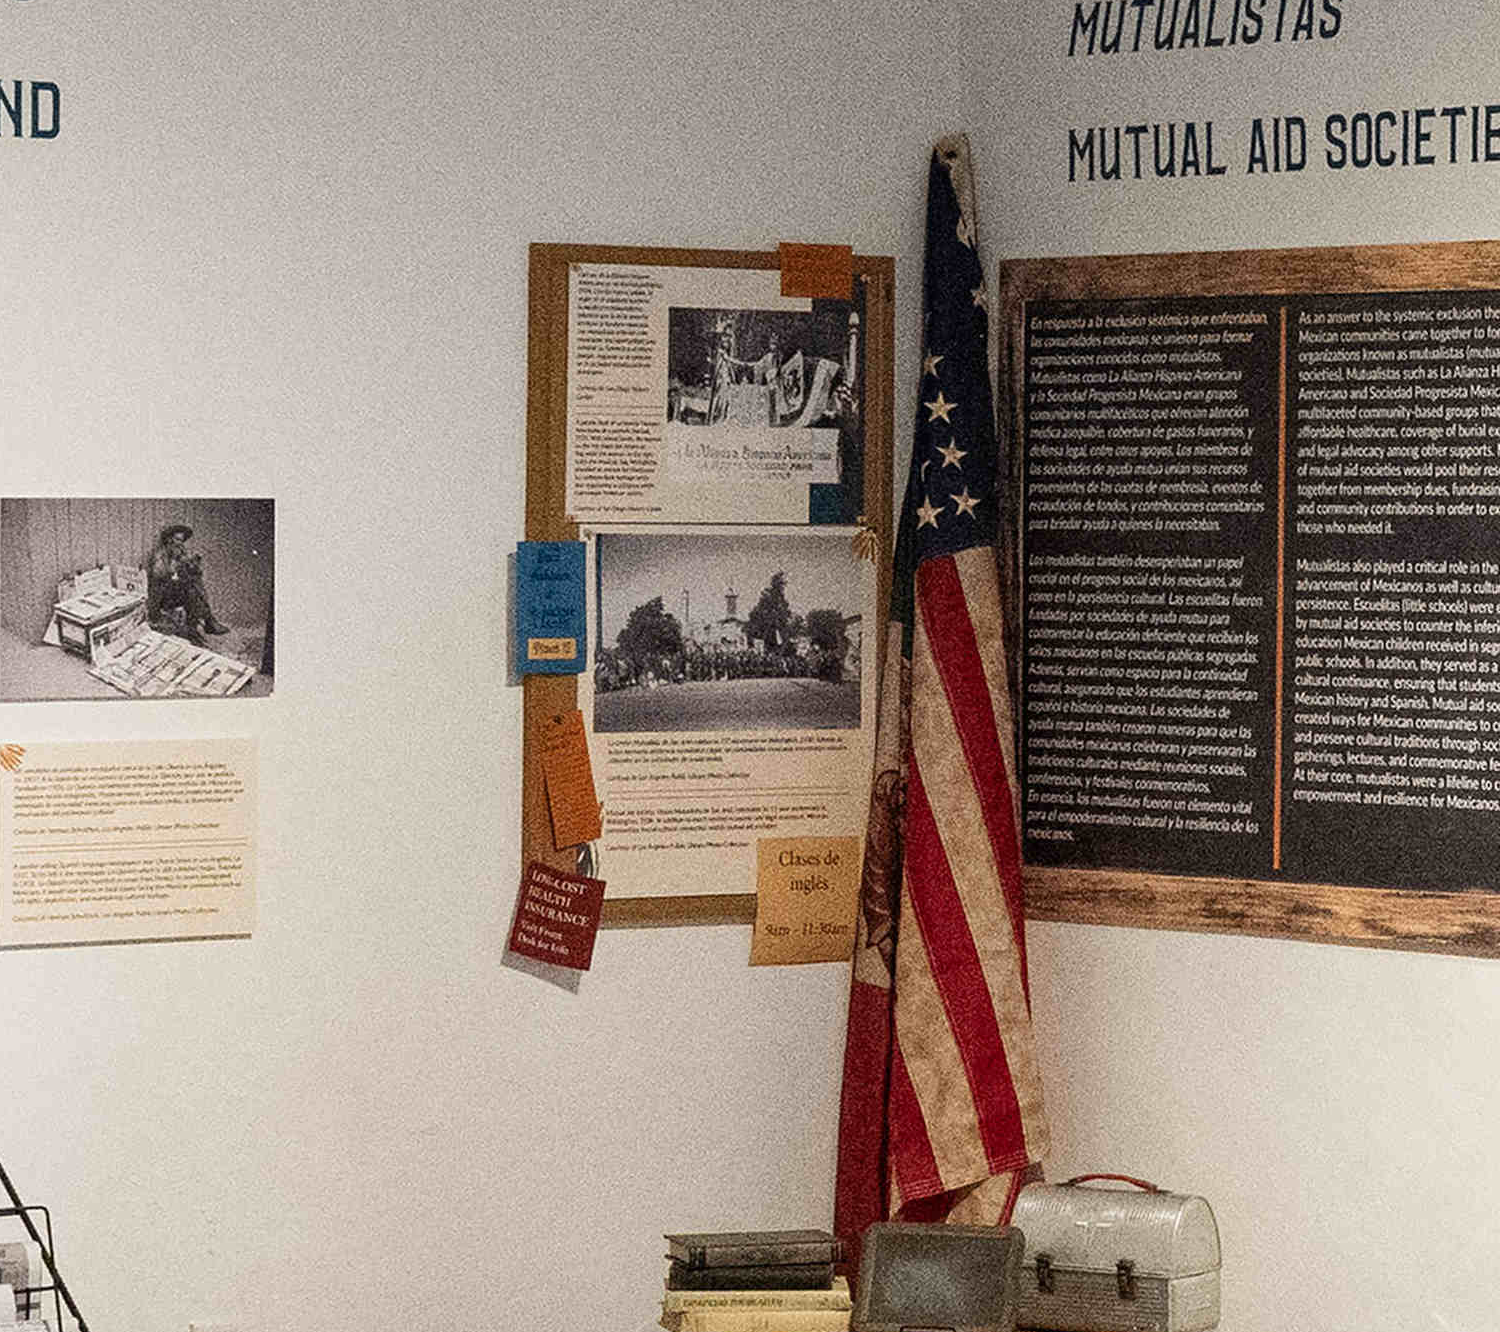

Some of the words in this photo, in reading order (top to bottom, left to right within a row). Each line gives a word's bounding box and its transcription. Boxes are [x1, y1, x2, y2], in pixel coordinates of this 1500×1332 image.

[1068, 120, 1228, 183] MUTUAL
[1247, 116, 1307, 174] AID
[1297, 520, 1323, 534] those
[1325, 521, 1346, 534] who
[1348, 521, 1383, 534] needed
[1385, 521, 1394, 534] it.
[778, 851, 821, 867] Clases
[824, 850, 840, 866] de
[524, 900, 590, 926] INSURANCE
